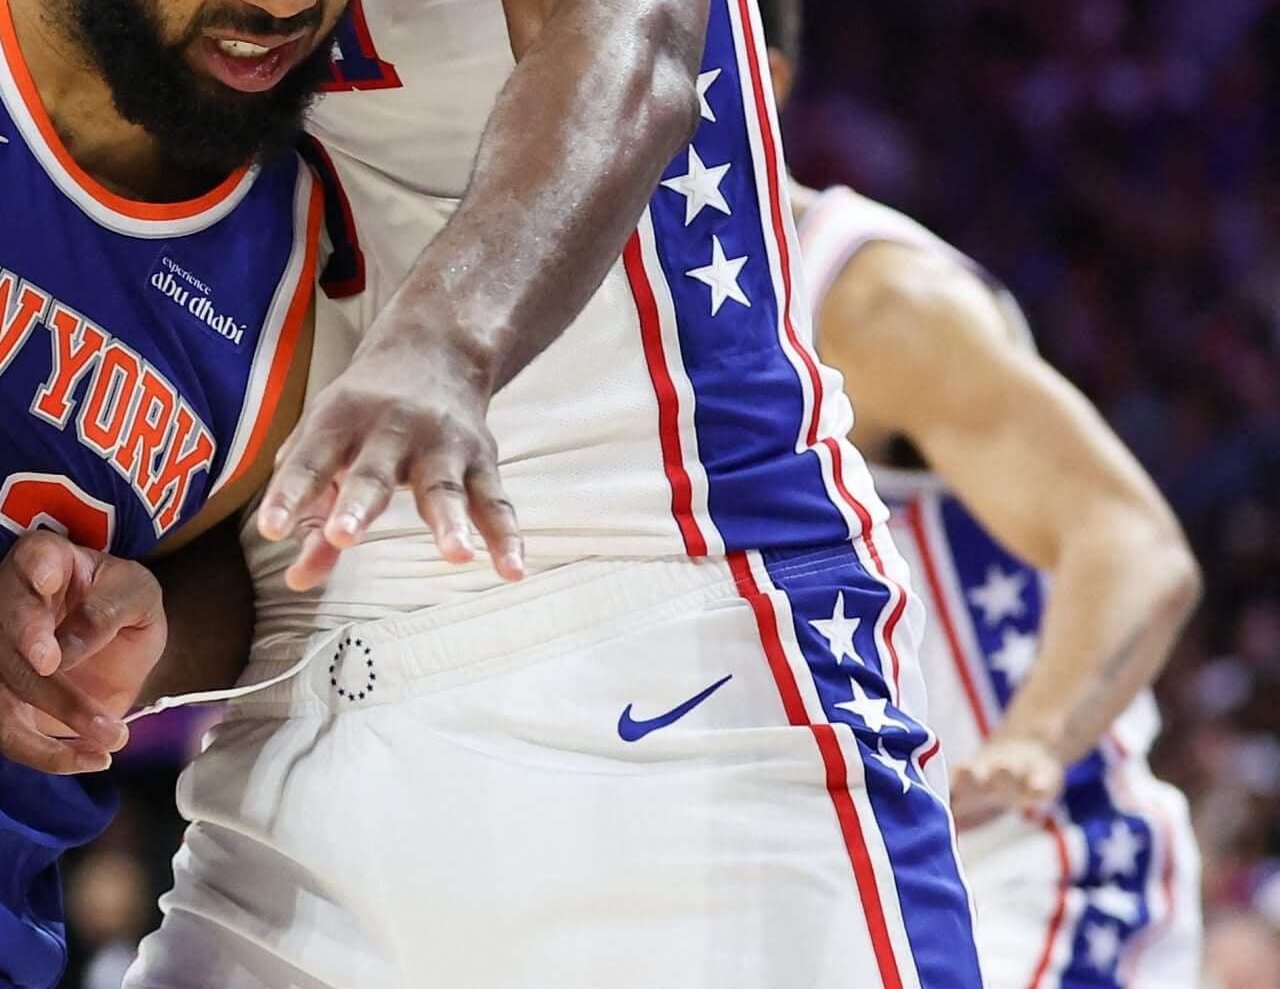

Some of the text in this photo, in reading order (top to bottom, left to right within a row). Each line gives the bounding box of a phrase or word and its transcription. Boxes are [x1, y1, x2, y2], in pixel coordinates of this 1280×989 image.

[151, 271, 189, 307] abu
[161, 256, 212, 295] experience
[28, 297, 218, 541] YORK
